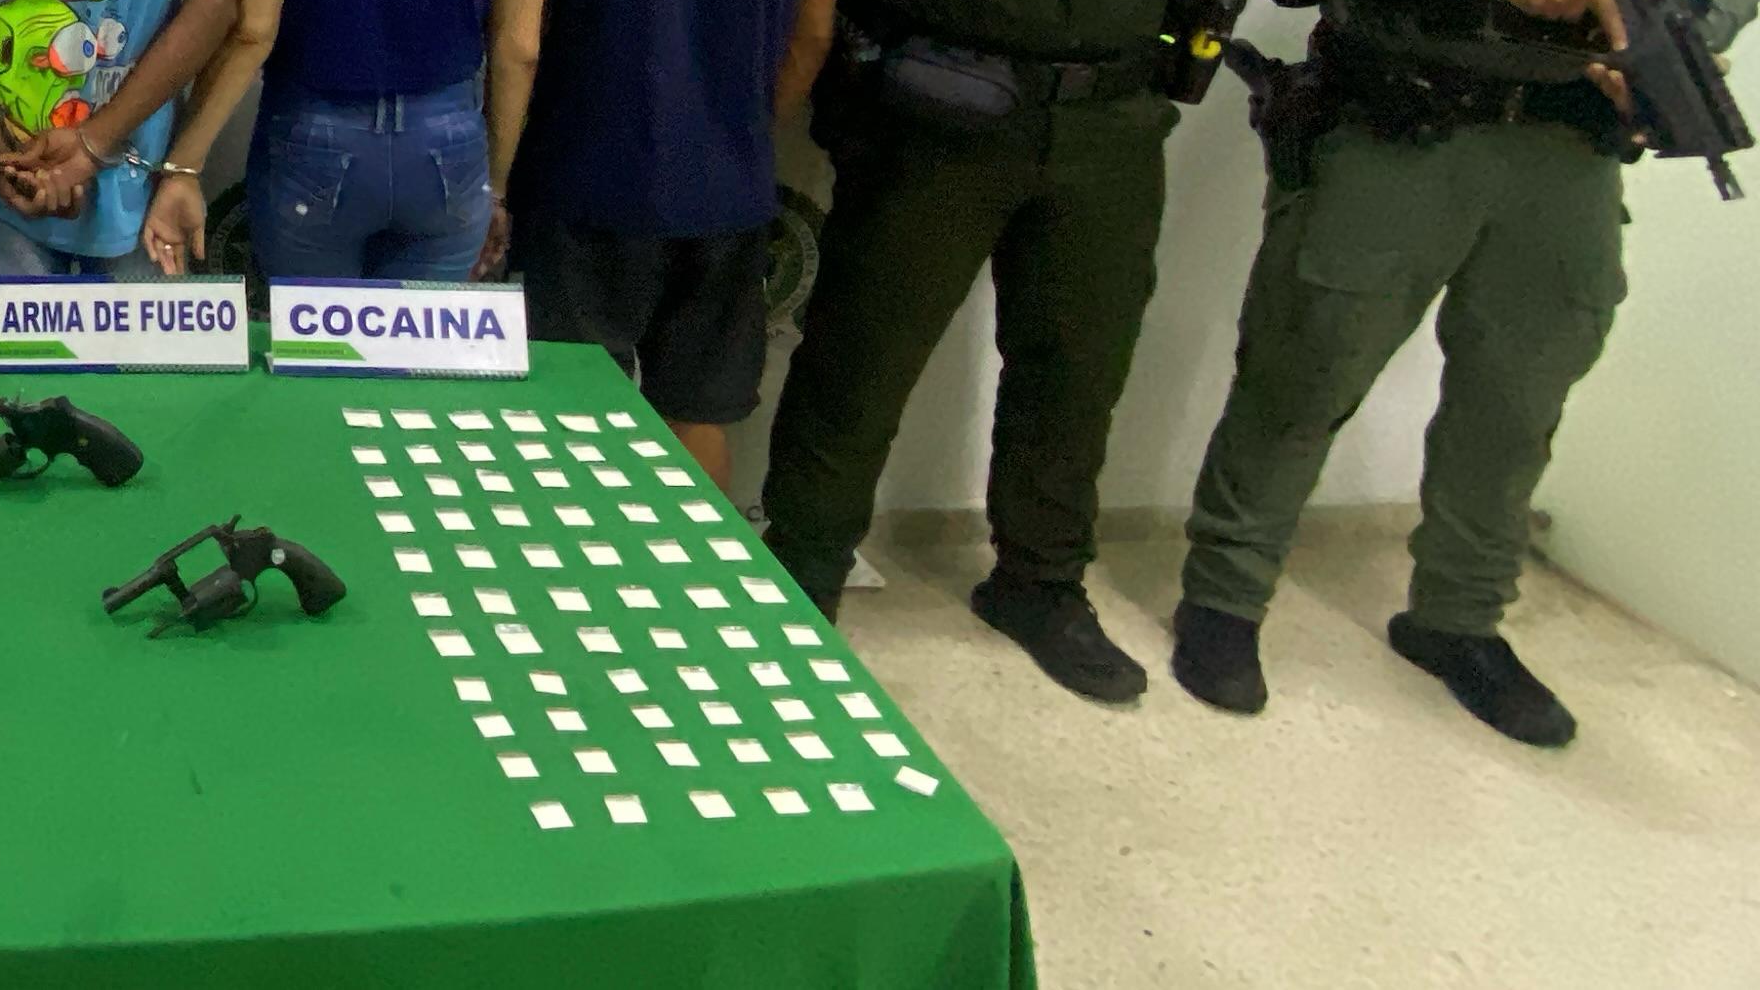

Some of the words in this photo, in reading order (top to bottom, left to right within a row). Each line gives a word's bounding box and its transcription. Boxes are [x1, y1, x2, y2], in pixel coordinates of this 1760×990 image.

[1, 300, 85, 333] ARMA
[94, 300, 130, 333] DE
[139, 300, 236, 332] FUEGO
[290, 304, 505, 340] COCAINA
